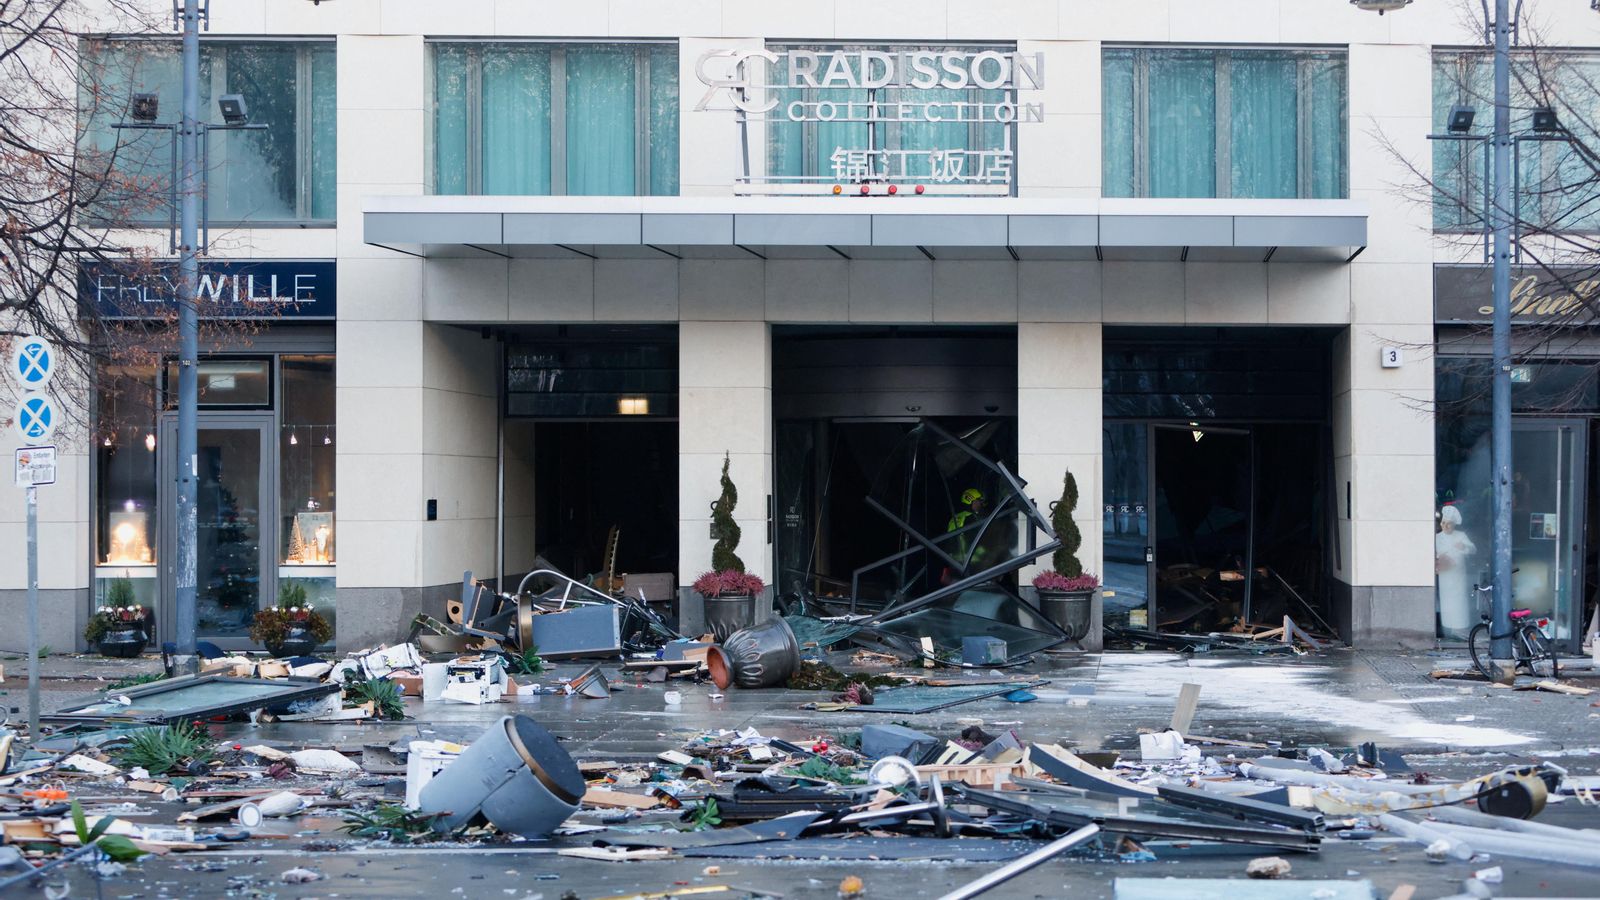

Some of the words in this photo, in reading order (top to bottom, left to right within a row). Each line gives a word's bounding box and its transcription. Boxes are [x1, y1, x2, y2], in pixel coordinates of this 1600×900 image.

[788, 50, 1045, 90] RADISSON
[787, 100, 1045, 123] COLLECTION
[830, 146, 1014, 184] 锦江饭店
[1389, 350, 1397, 362] 3
